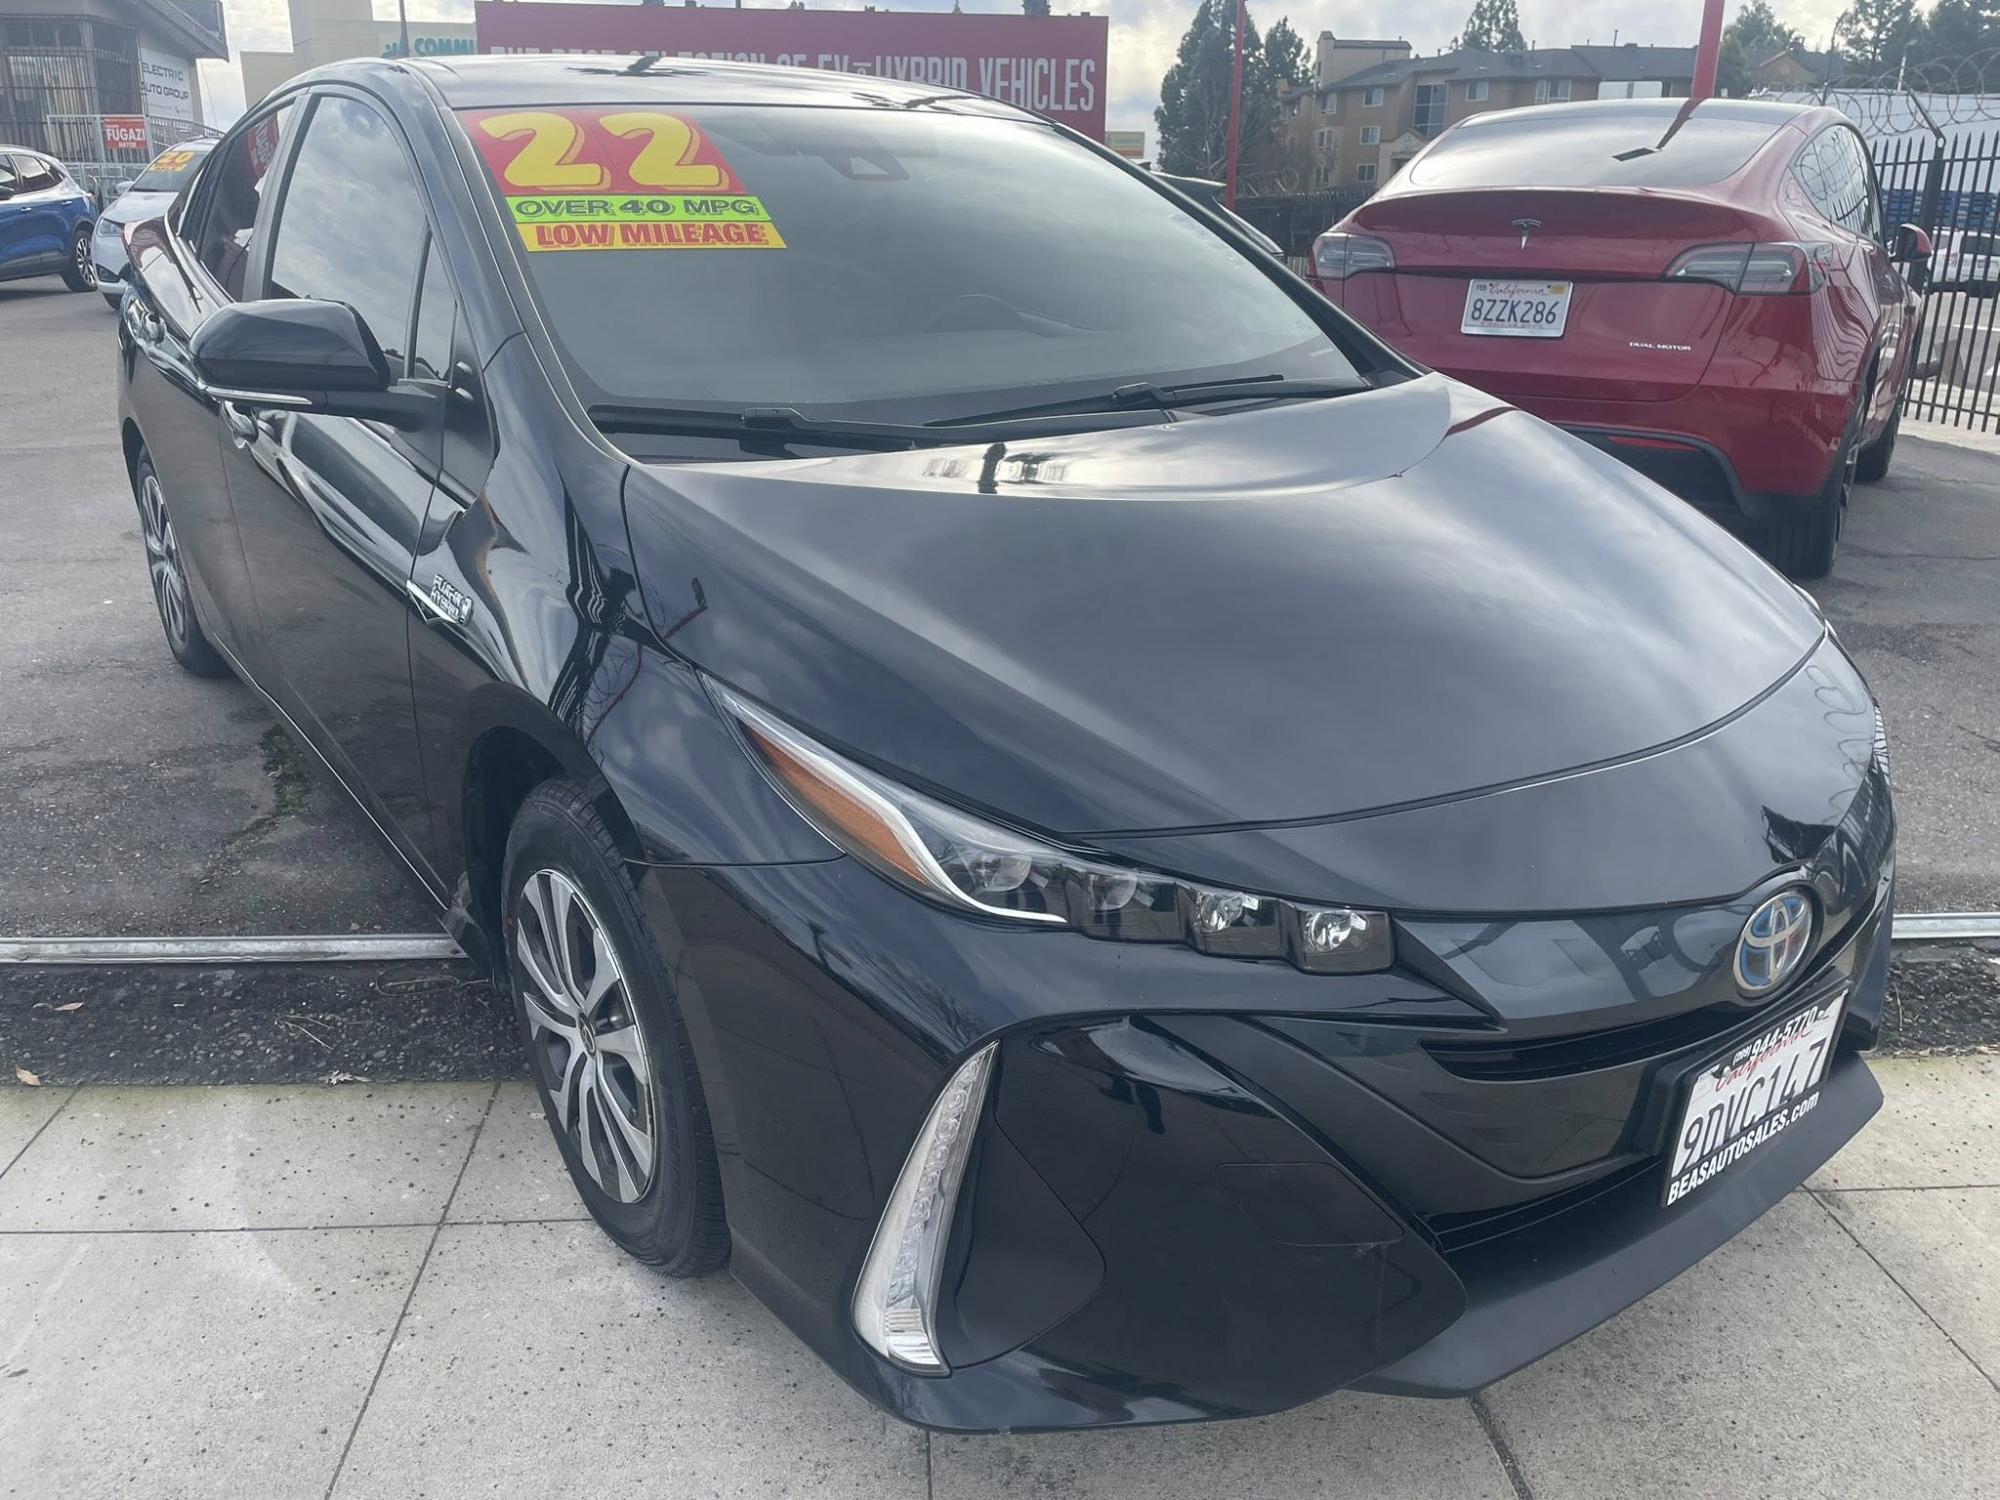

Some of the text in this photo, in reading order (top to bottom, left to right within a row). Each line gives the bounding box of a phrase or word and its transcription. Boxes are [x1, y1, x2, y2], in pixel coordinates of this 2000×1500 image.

[142, 62, 183, 81] ELECTRIC
[141, 82, 189, 100] AUTO GROUP
[980, 57, 1096, 111] VEHICLES
[106, 128, 145, 141] FUGAZI
[479, 112, 731, 190] 22
[515, 199, 760, 217] OVER 40 MPG
[536, 223, 769, 247] LOW MILEAGE
[1489, 281, 1546, 297] California
[1471, 298, 1559, 324] 8ZZK286
[1629, 341, 1691, 351] DUAL MOTOR
[1752, 1005, 1818, 1057] 944-5770
[1684, 1037, 1827, 1168] 9DVC147
[1667, 1092, 1819, 1206] BEASAUTOSALES.com
